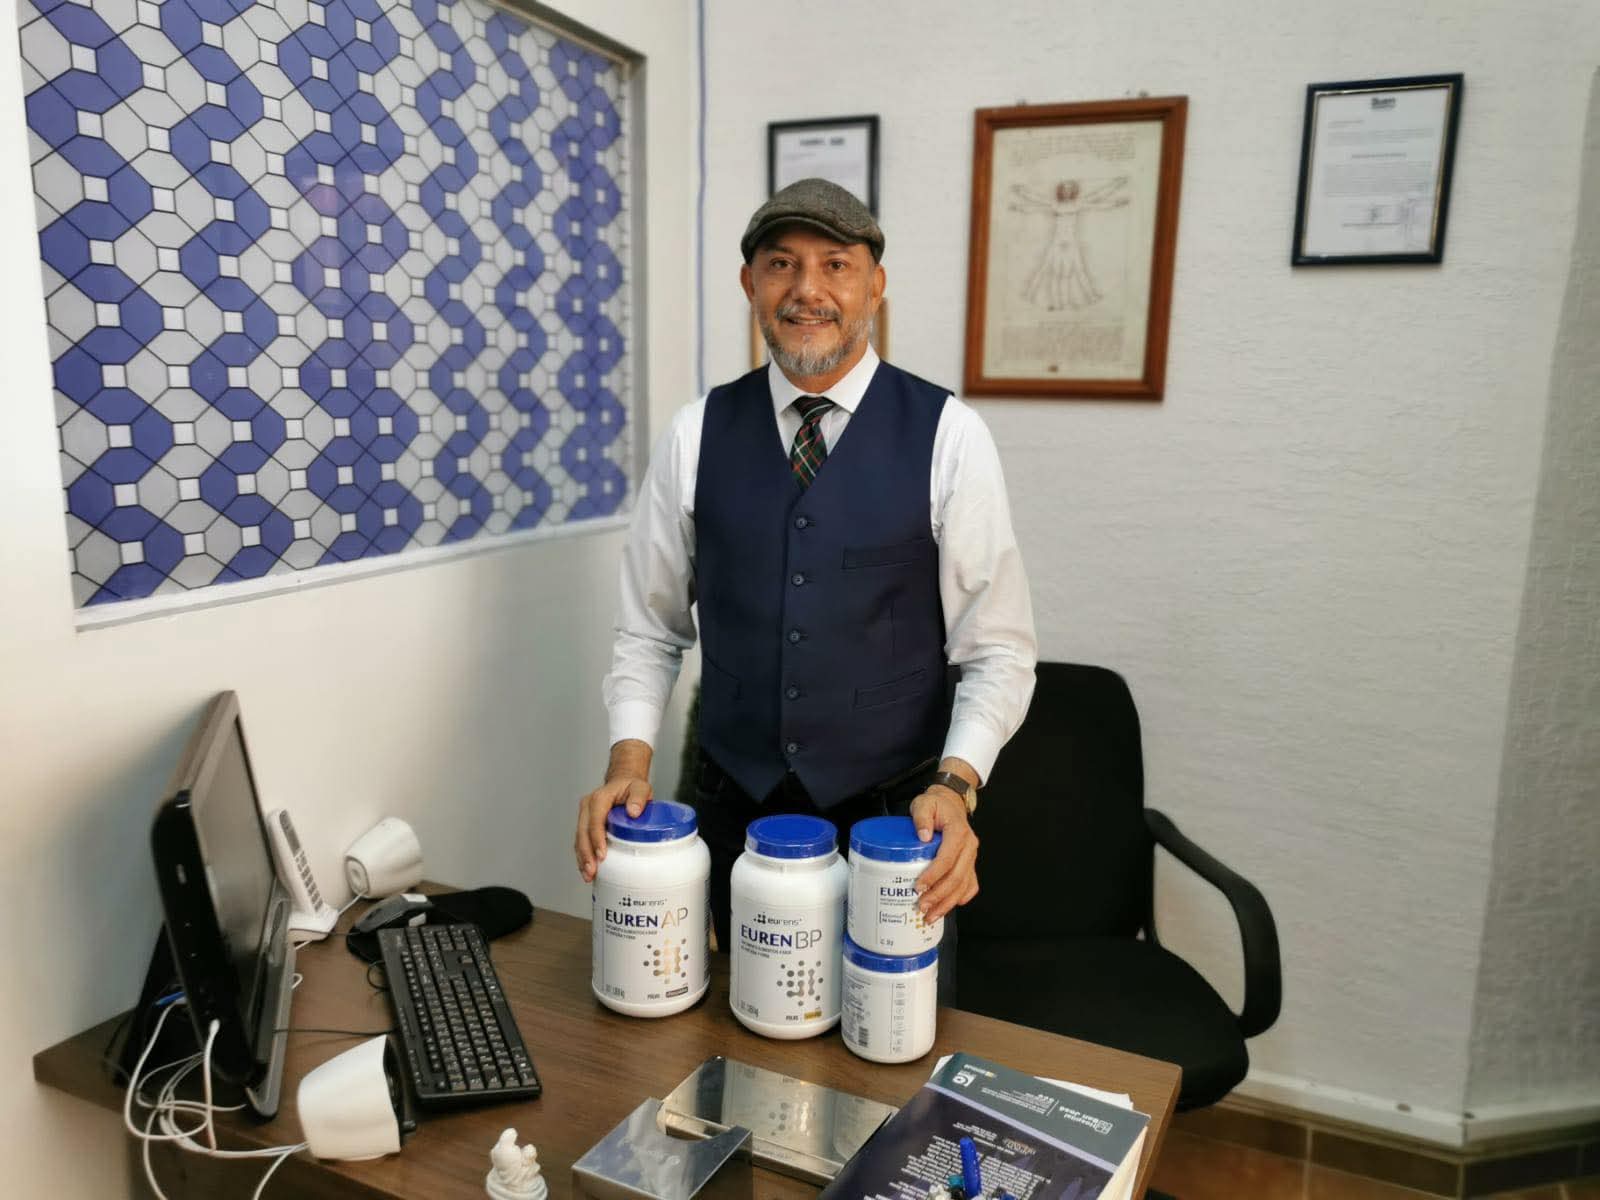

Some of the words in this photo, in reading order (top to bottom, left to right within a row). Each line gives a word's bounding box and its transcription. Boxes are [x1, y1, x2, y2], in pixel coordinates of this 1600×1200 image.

[880, 887, 919, 897] EUREN
[605, 908, 658, 928] EUREN
[661, 907, 689, 929] AP
[767, 918, 799, 926] eurens
[741, 924, 793, 948] EUREN
[795, 929, 822, 950] BP
